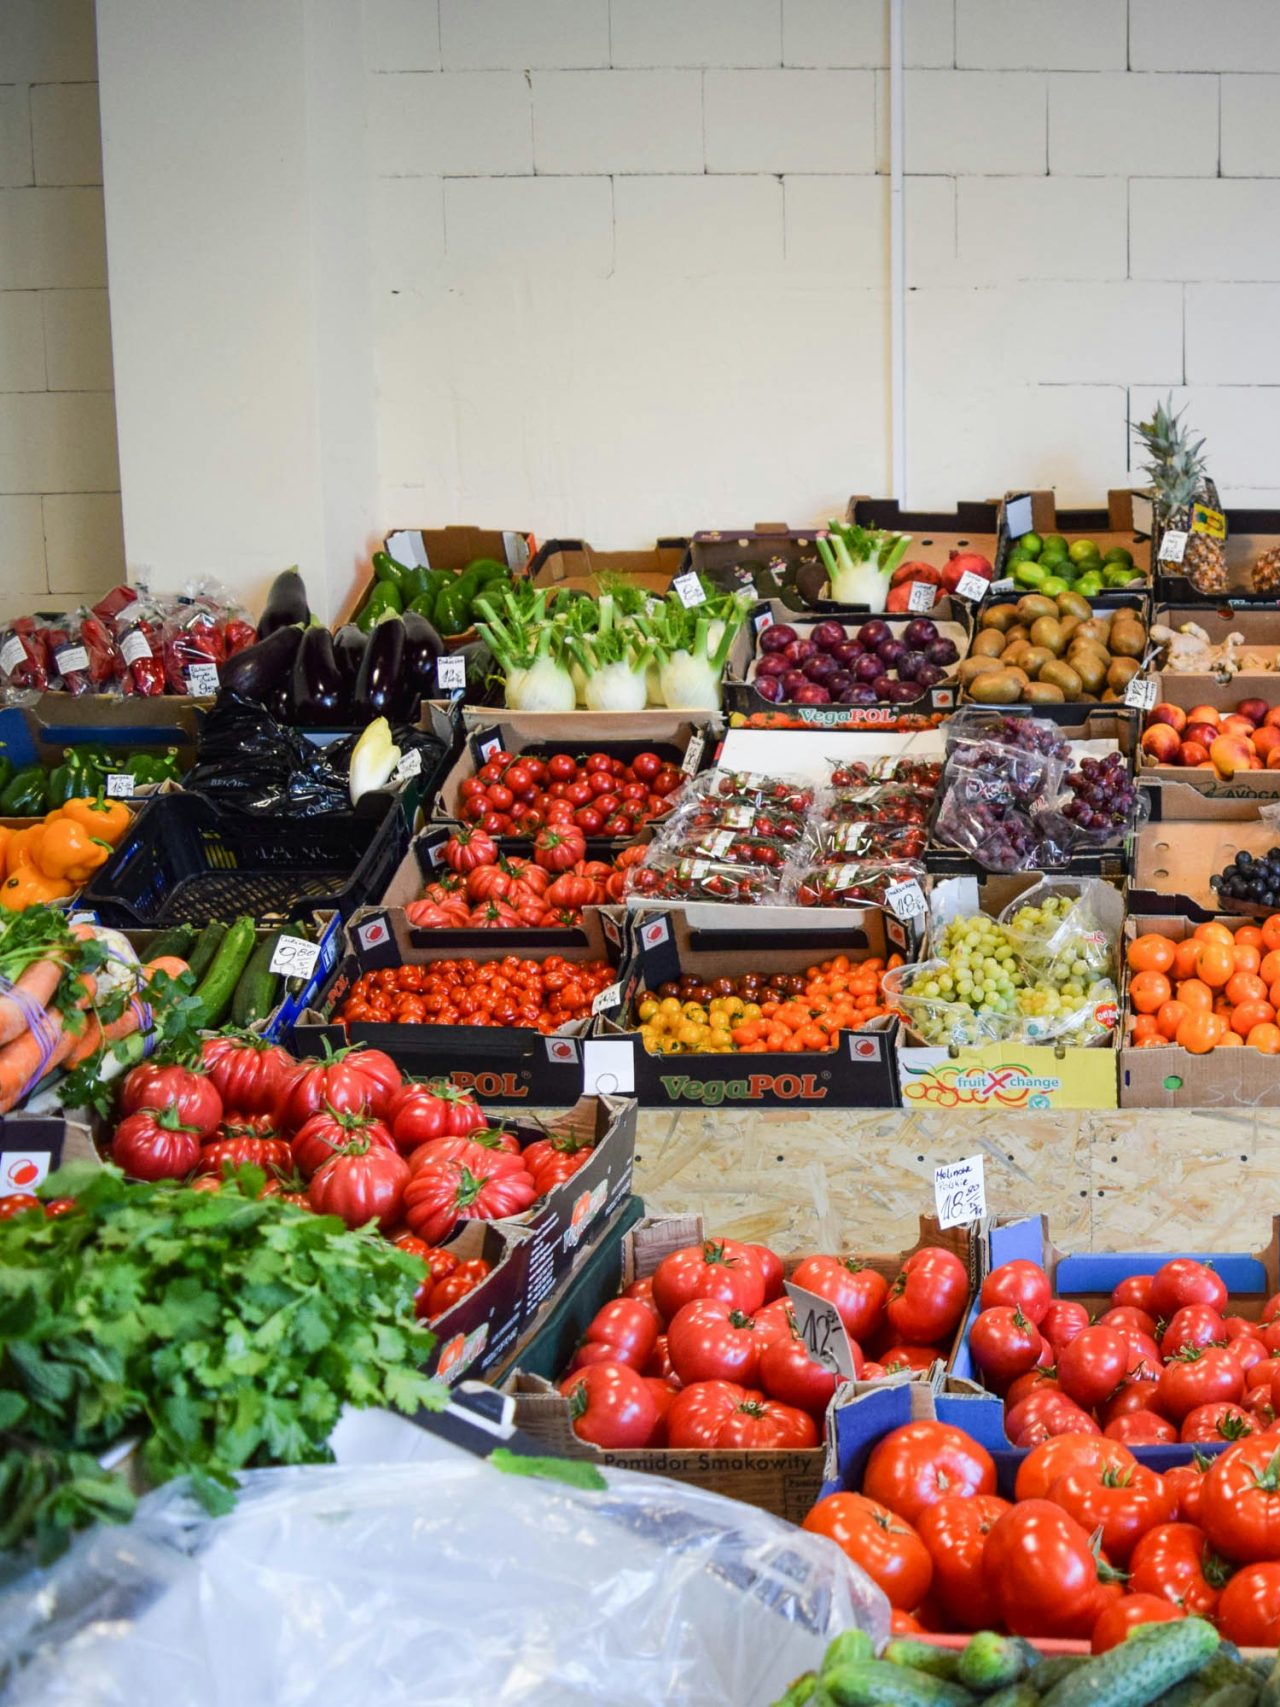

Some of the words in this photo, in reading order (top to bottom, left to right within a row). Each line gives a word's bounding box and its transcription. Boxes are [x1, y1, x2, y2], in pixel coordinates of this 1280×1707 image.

[800, 708, 897, 725] VegaPOL
[660, 1074, 828, 1106] VegaPOL
[604, 1453, 690, 1472] Pomidor
[698, 1453, 812, 1473] Smakowity
